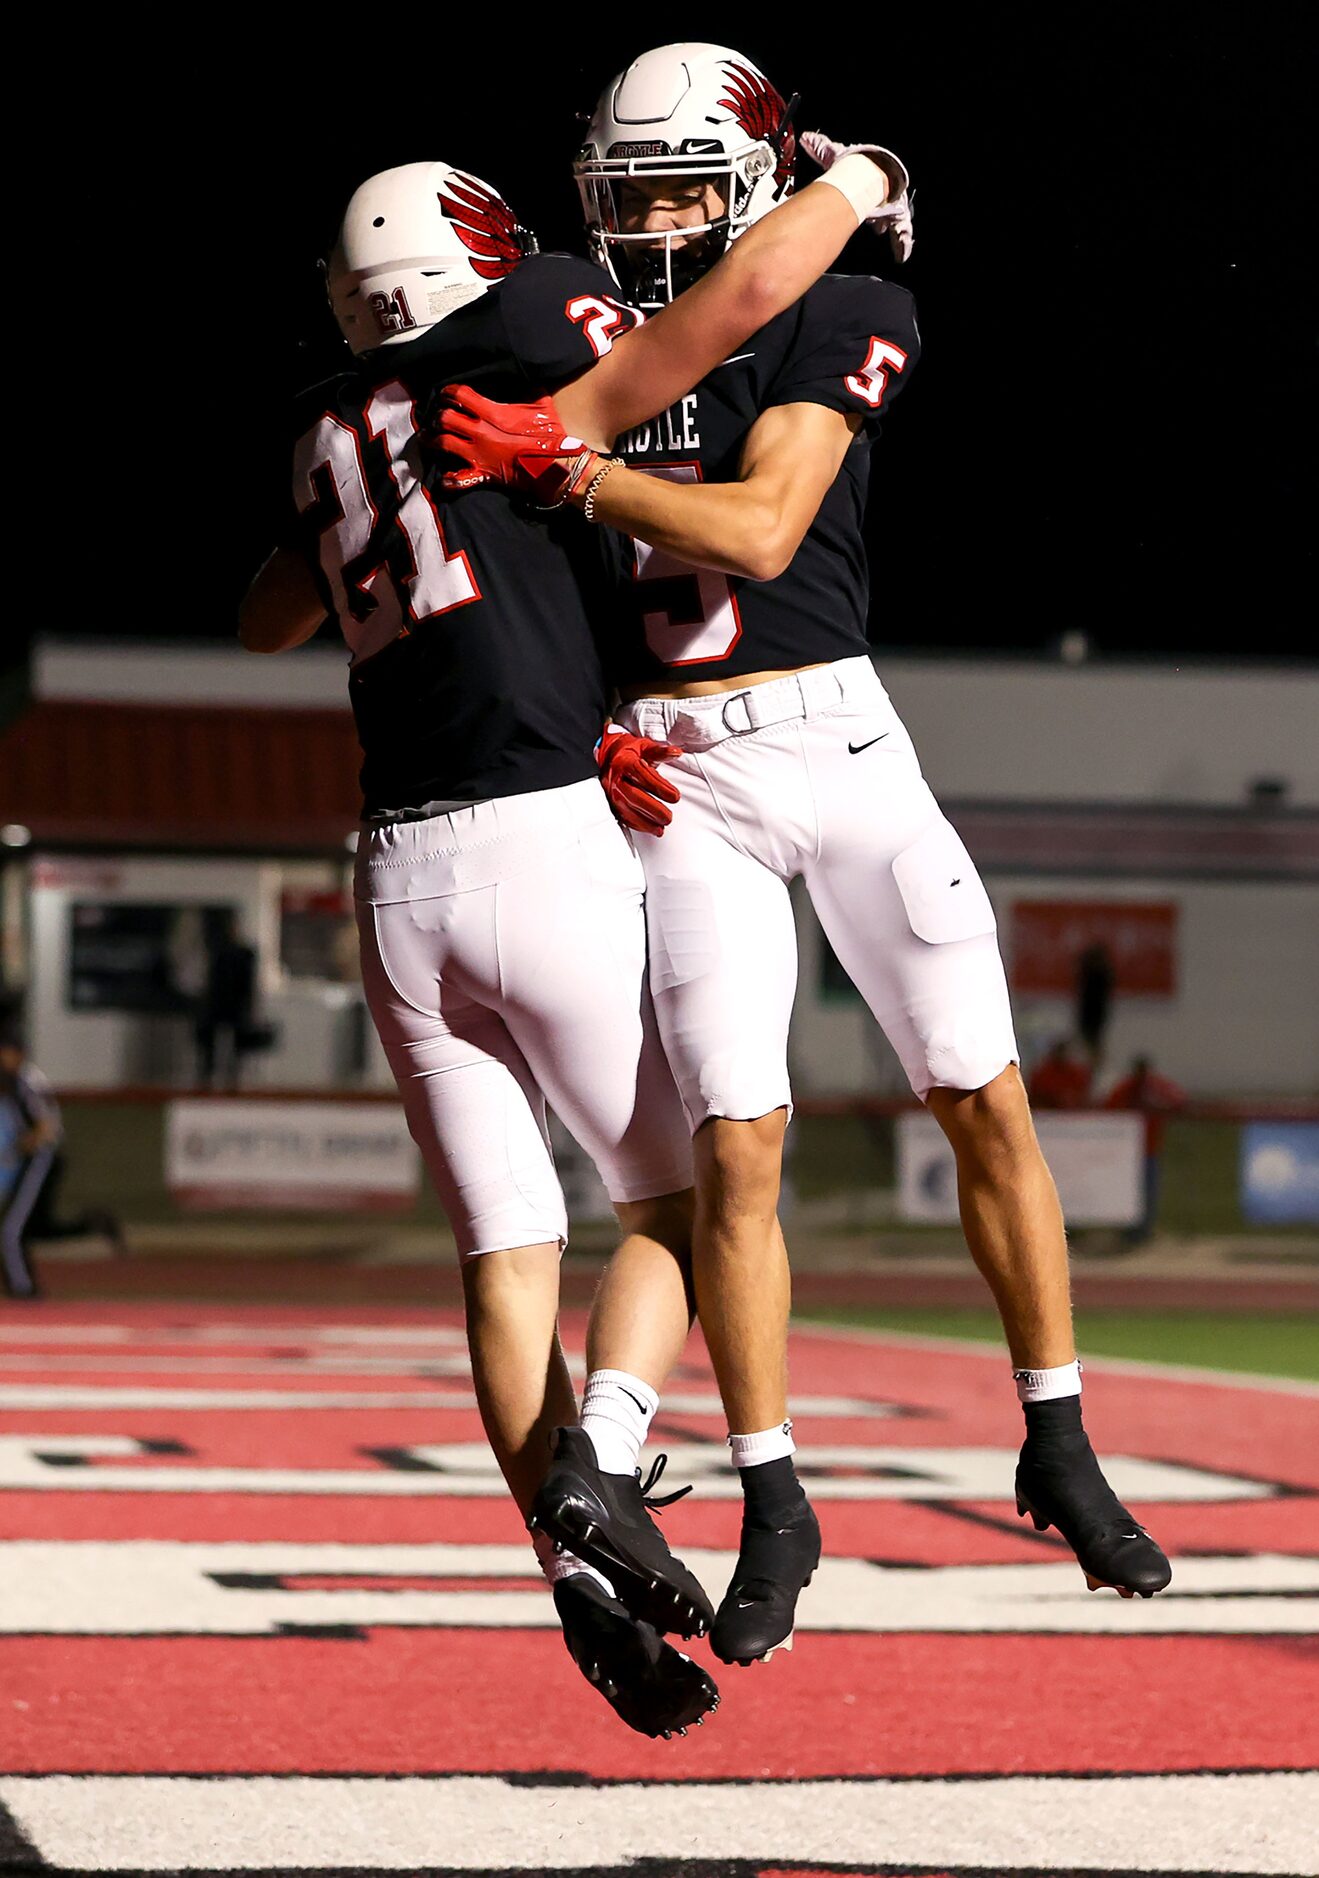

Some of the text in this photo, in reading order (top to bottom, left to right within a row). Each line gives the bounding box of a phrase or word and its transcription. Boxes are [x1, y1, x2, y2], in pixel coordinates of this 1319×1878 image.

[367, 286, 417, 333] 21
[844, 336, 908, 408] 5
[292, 376, 482, 672] 21
[626, 460, 743, 667] 5
